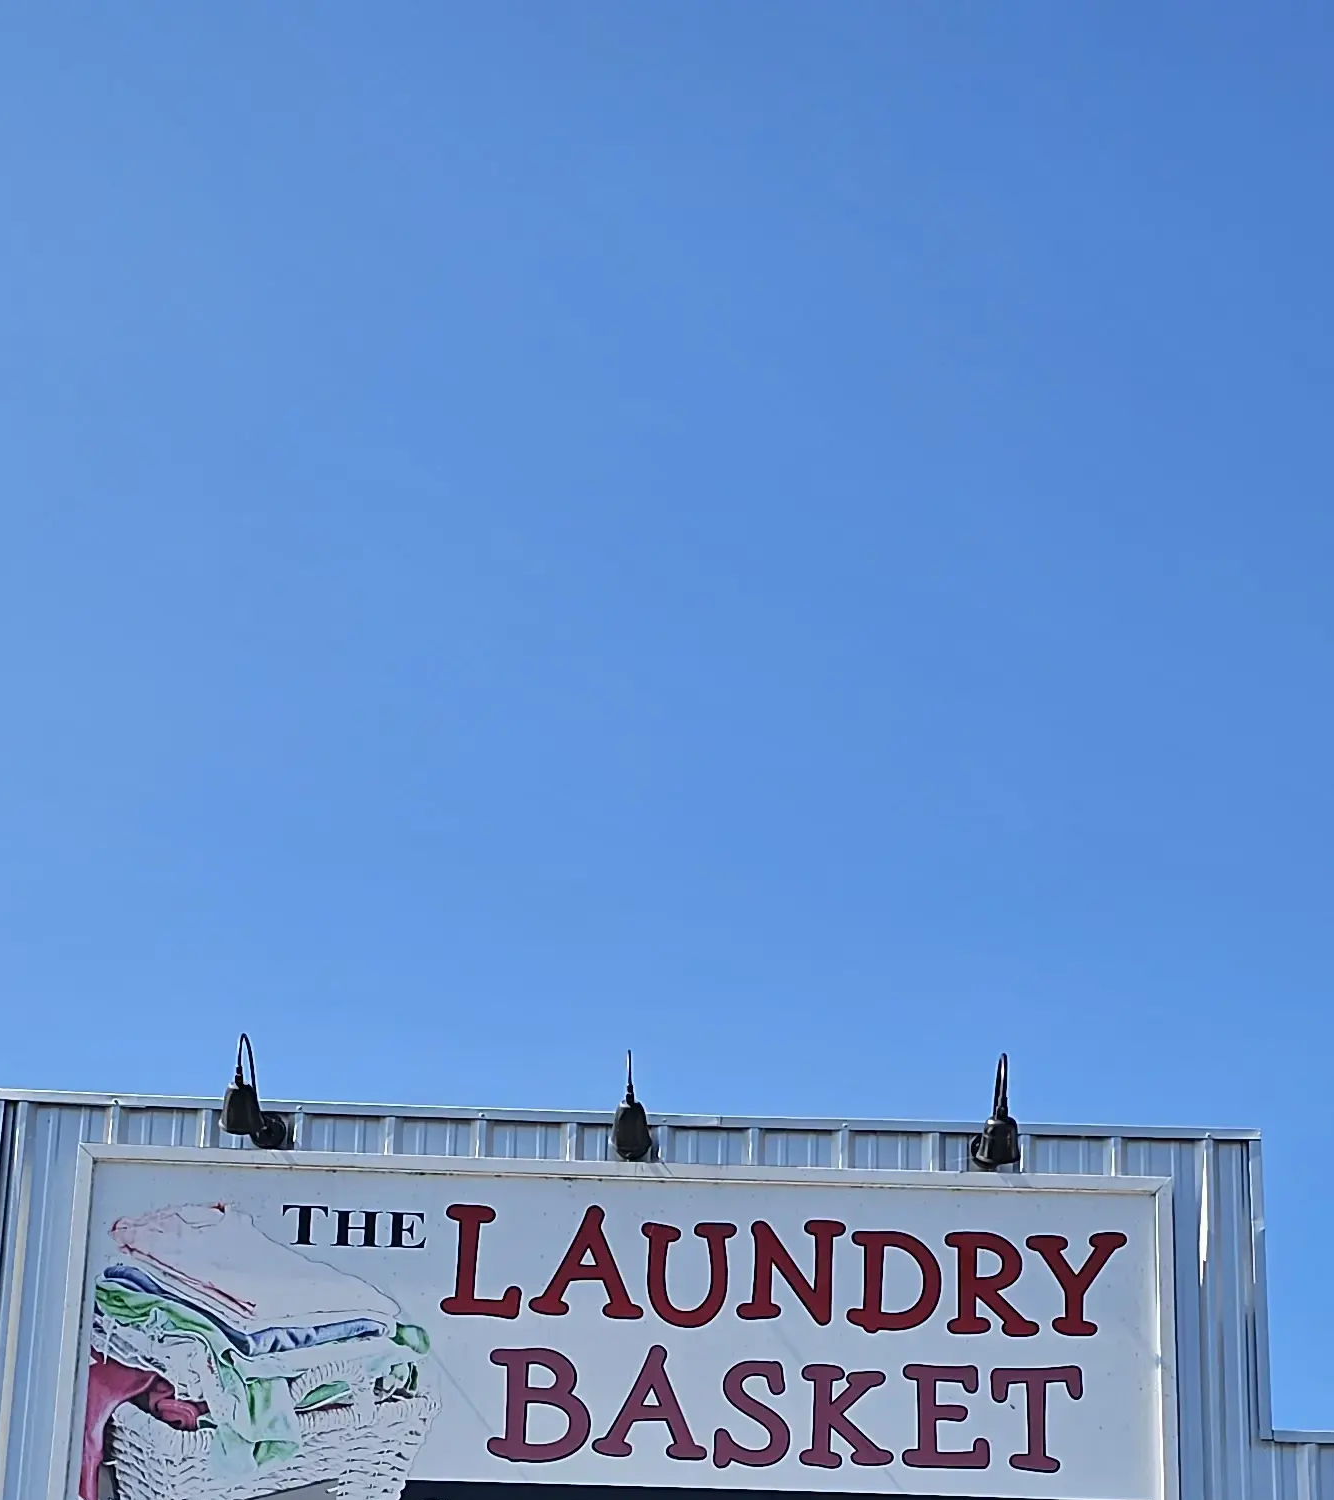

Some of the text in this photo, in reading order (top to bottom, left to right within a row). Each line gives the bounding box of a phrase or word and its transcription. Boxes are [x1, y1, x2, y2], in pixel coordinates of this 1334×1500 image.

[282, 1203, 1127, 1337] THE LAUNDRY
[486, 1344, 1083, 1474] BASKET
